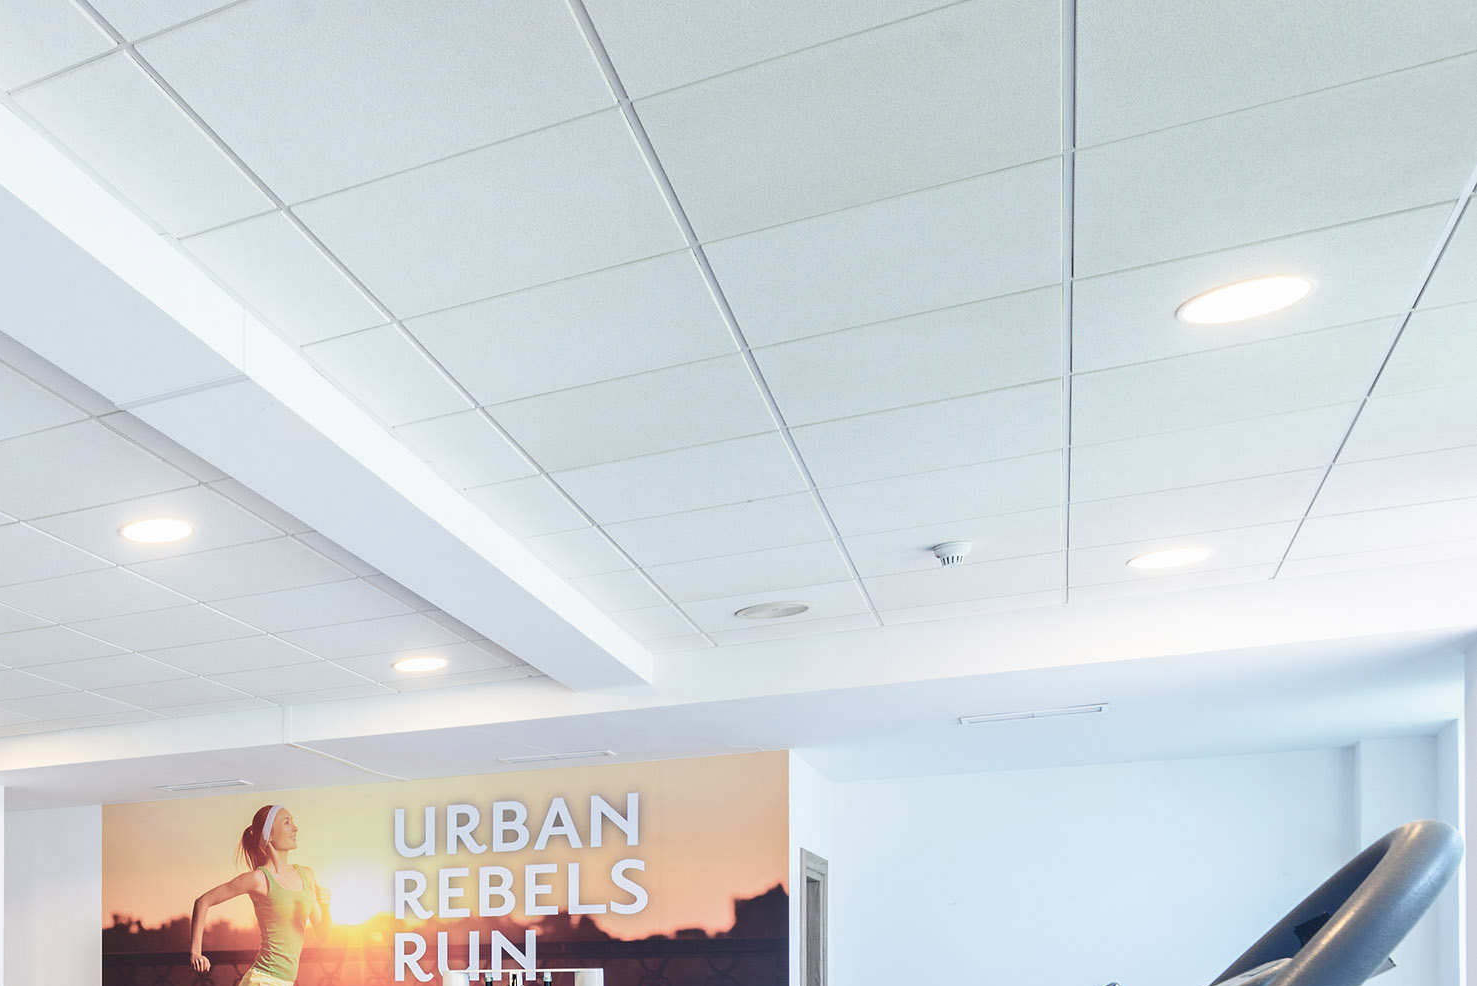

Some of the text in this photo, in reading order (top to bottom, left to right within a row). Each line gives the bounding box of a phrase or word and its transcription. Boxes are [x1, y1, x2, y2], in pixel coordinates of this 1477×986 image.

[394, 792, 639, 858] URBAN
[394, 858, 649, 920] REBELS
[394, 929, 537, 983] RUN
